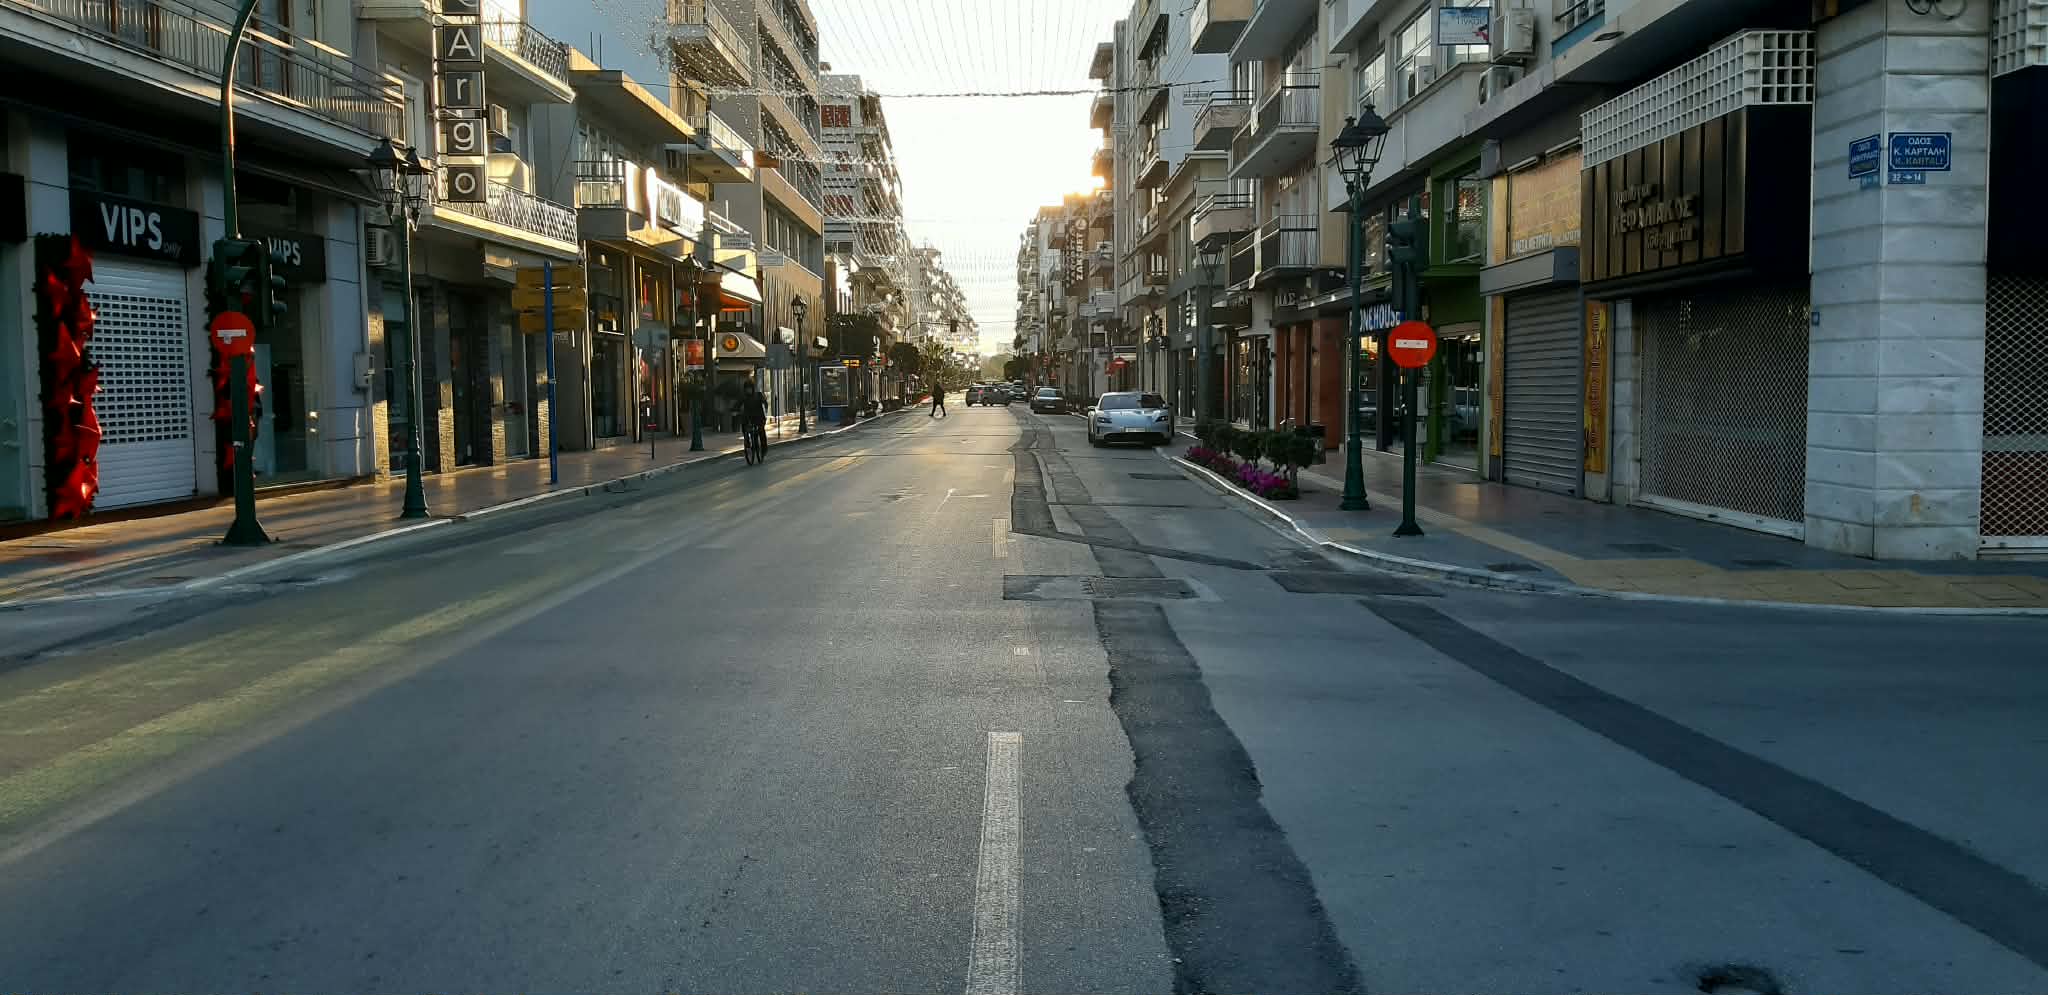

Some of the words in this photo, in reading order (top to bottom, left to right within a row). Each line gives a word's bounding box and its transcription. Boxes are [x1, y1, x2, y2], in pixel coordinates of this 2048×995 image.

[1908, 137, 1932, 145] ΟΔΟΣ
[1905, 148, 1945, 156] ΚΑΡΤΑΛΗ
[100, 202, 163, 250] VIPS
